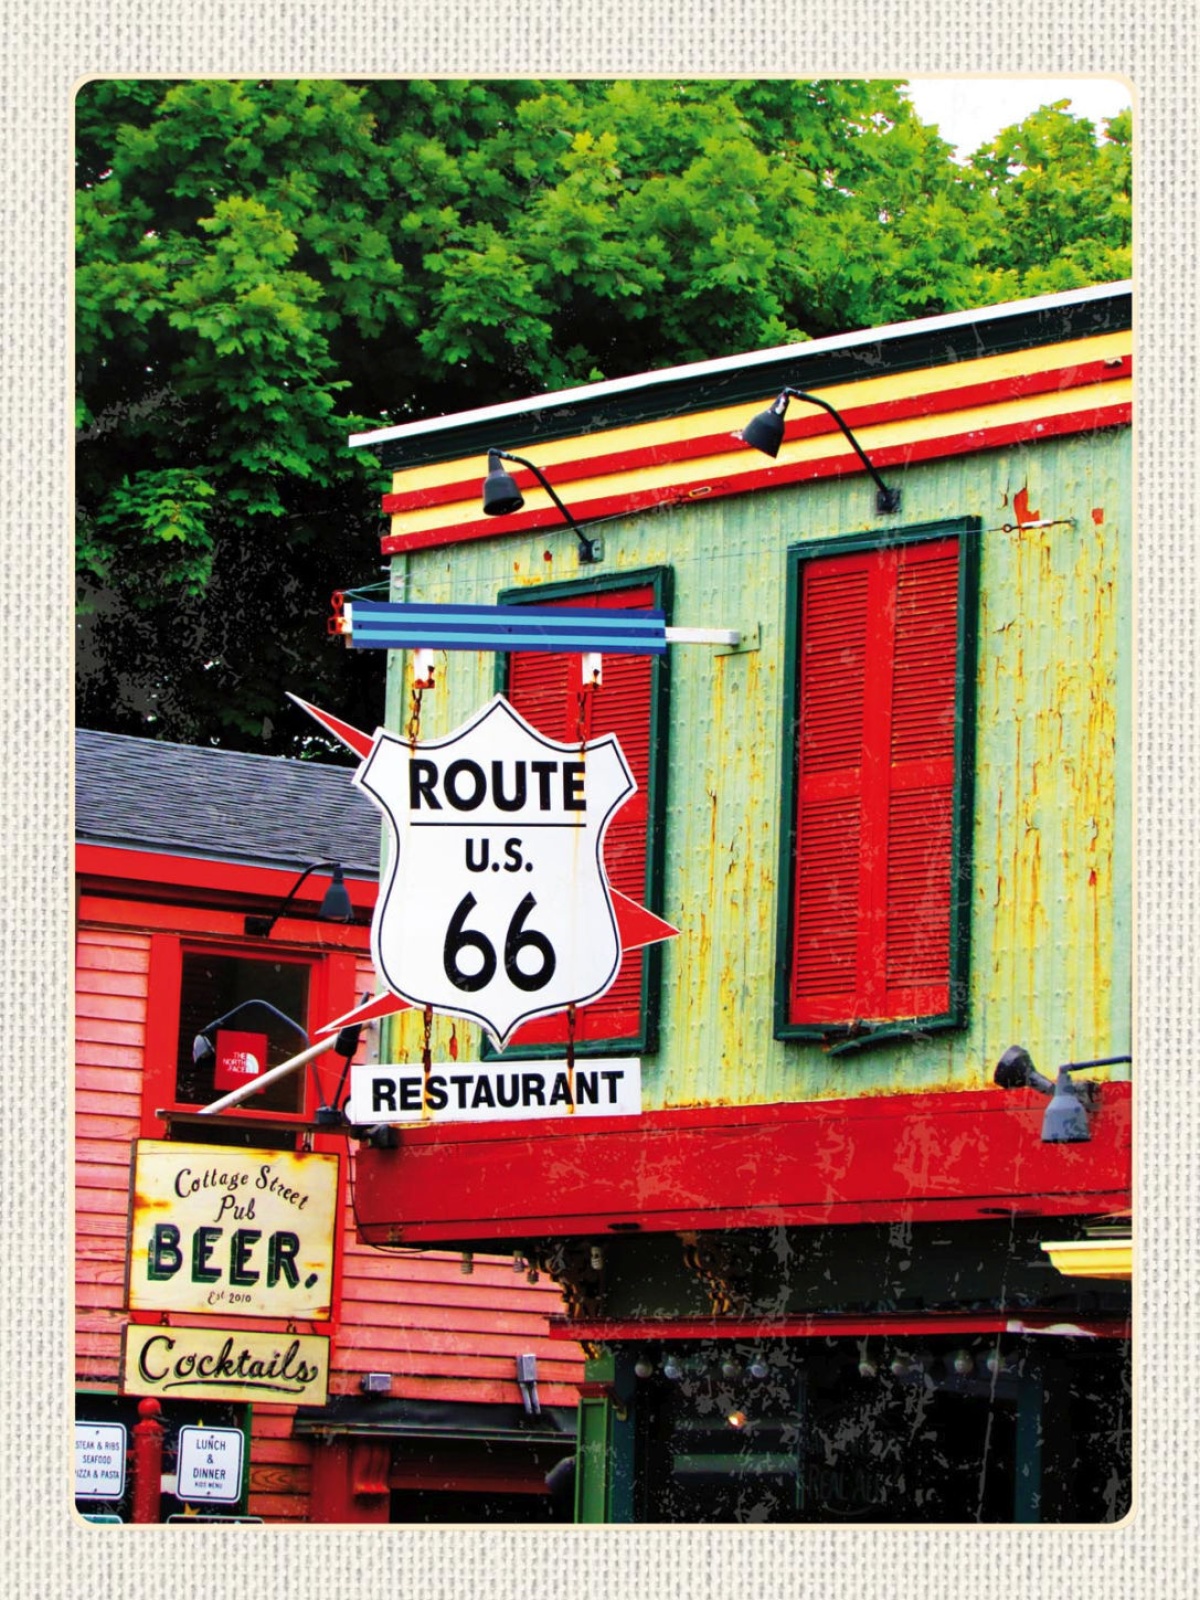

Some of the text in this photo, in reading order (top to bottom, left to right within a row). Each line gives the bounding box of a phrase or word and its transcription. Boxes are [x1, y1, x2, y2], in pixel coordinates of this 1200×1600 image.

[409, 758, 587, 812] ROUTE
[465, 837, 534, 873] U.S.
[443, 891, 557, 993] 66
[233, 1051, 246, 1060] THE
[371, 1070, 625, 1112] RESTAURANT
[174, 1164, 309, 1211] Cottage Street
[213, 1194, 256, 1223] Pub
[229, 1292, 252, 1304] 2010
[138, 1334, 319, 1382] Cocktails
[75, 1440, 120, 1451] STEAK & RIBS
[196, 1439, 226, 1451] LUNCH
[82, 1454, 112, 1465] SEAFOOD
[206, 1453, 214, 1465] &
[75, 1468, 120, 1480] IZZA & PASTA
[192, 1467, 226, 1480] DINNER
